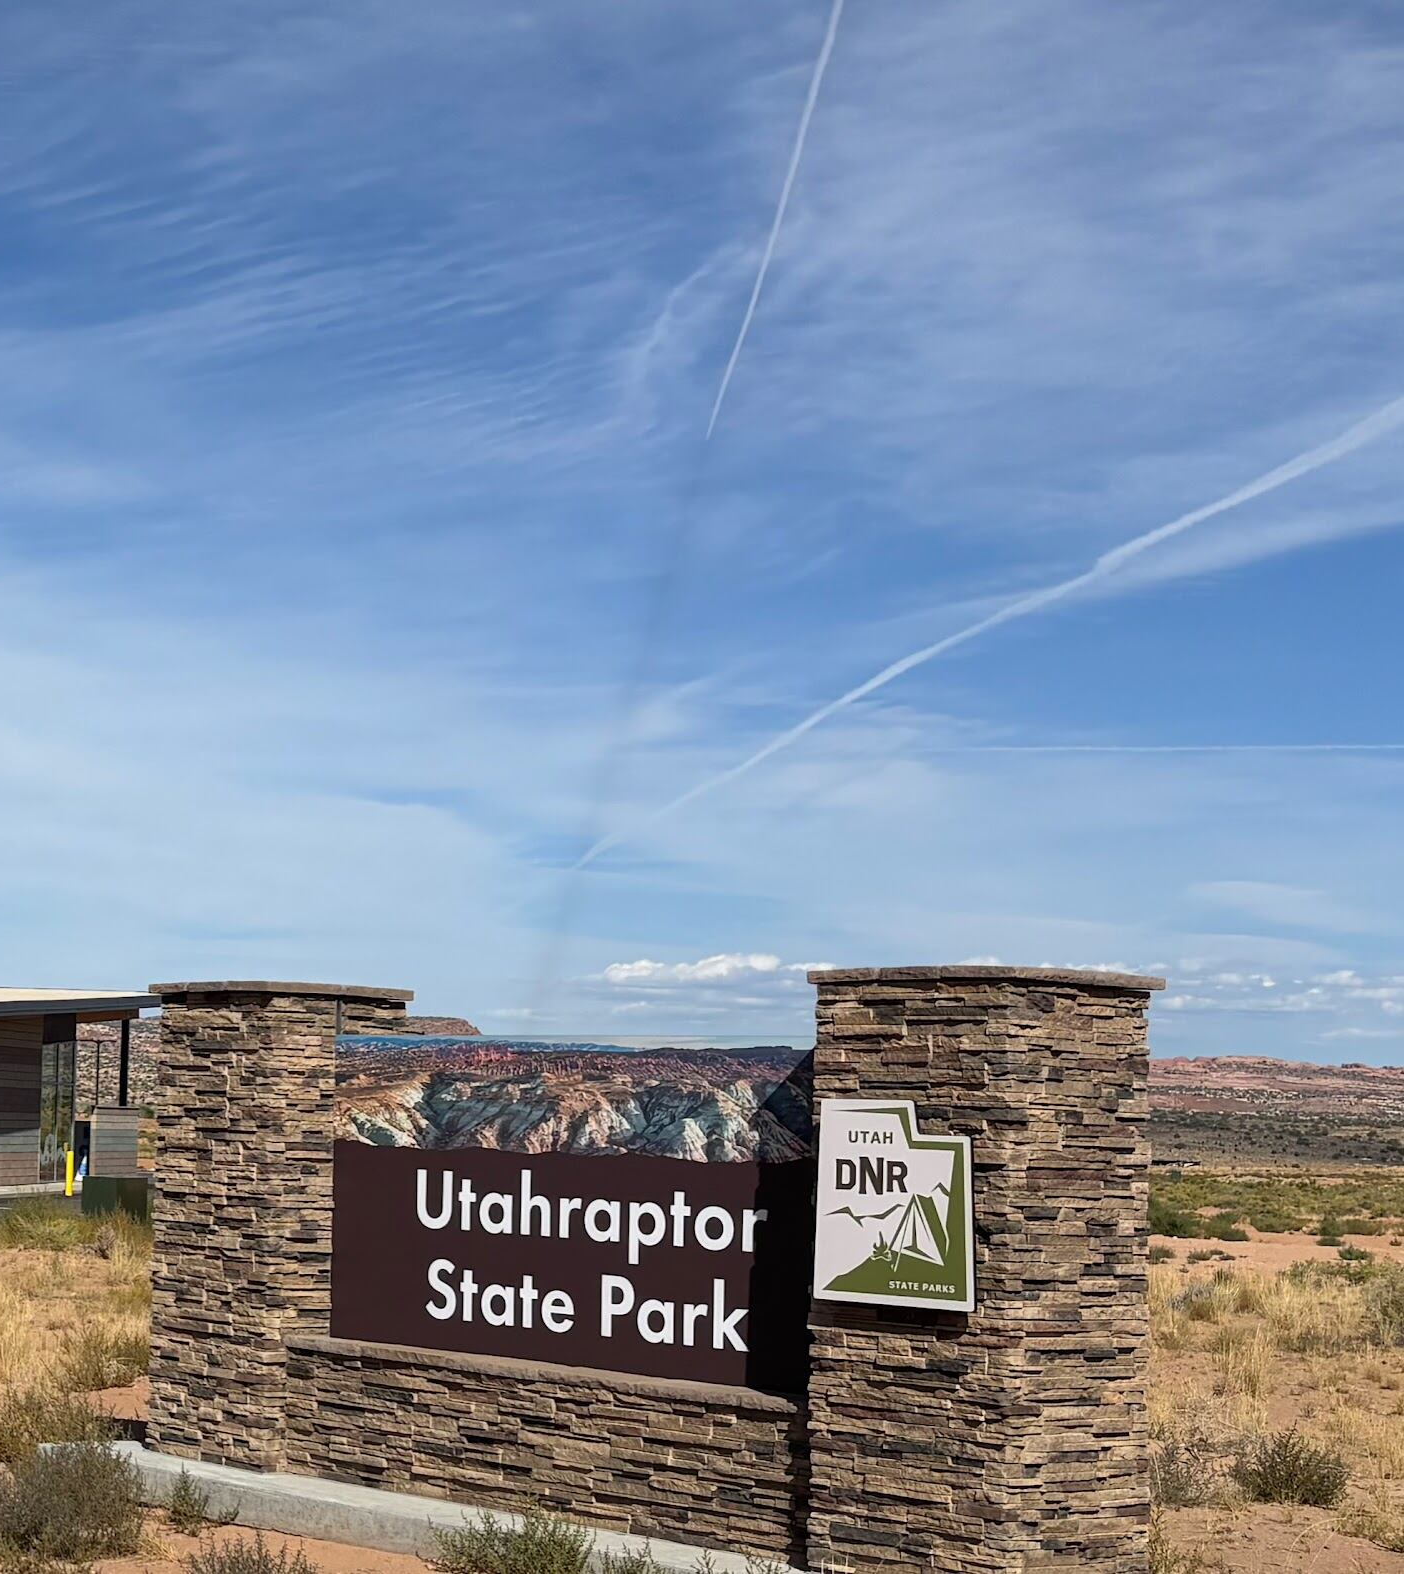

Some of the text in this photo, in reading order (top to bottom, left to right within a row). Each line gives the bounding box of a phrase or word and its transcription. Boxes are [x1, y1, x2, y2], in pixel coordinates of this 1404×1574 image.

[848, 1130, 893, 1144] UTAH
[835, 1156, 908, 1195] DNR
[416, 1168, 768, 1264] Utahraptor
[425, 1258, 750, 1352] State Park
[888, 1280, 956, 1294] STATE PARKS
